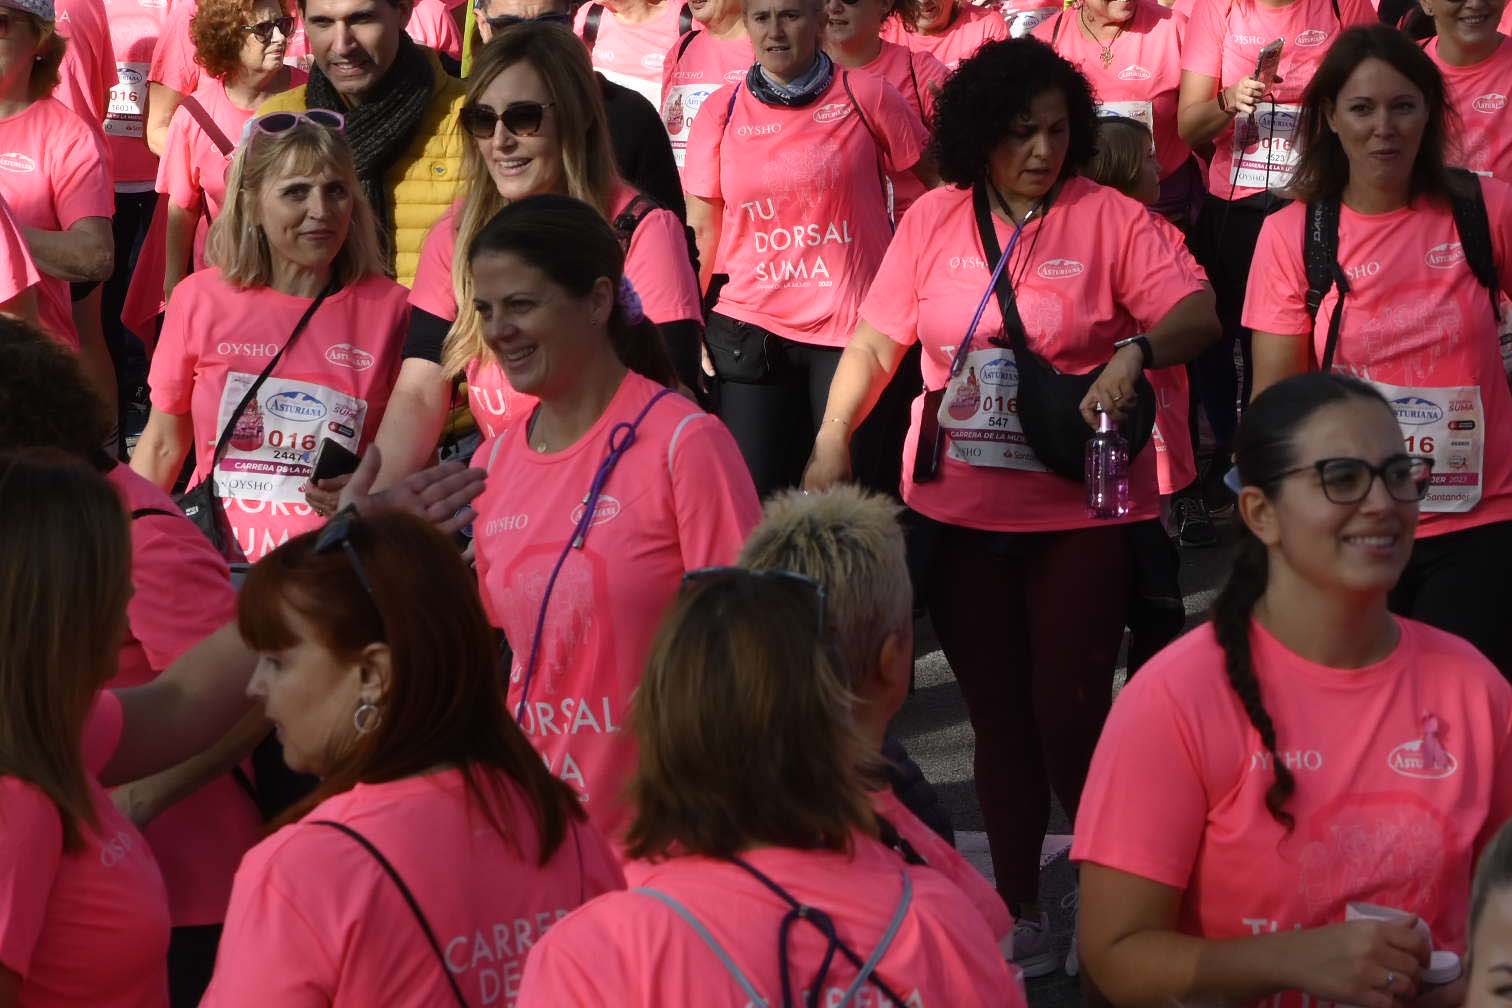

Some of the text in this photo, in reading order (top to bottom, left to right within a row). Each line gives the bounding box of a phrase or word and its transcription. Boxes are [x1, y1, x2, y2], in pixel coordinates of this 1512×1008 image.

[737, 123, 782, 137] OYSHO
[740, 197, 775, 222] TU
[754, 220, 853, 254] DORSAL
[755, 254, 831, 283] SUMA
[1345, 261, 1381, 281] SHO
[216, 341, 280, 358] OYSHO
[270, 398, 322, 417] ASTURIANA
[982, 395, 1018, 414] 016
[1390, 407, 1439, 421] STURIANA
[988, 416, 1008, 429] 547
[267, 429, 317, 451] 016
[1405, 435, 1435, 454] 16
[234, 461, 275, 473] CARRERA
[289, 467, 301, 475] LA
[229, 479, 274, 492] OYSHO
[1430, 475, 1447, 484] JER
[1426, 493, 1471, 502] Santander
[515, 696, 622, 737] ORSAL
